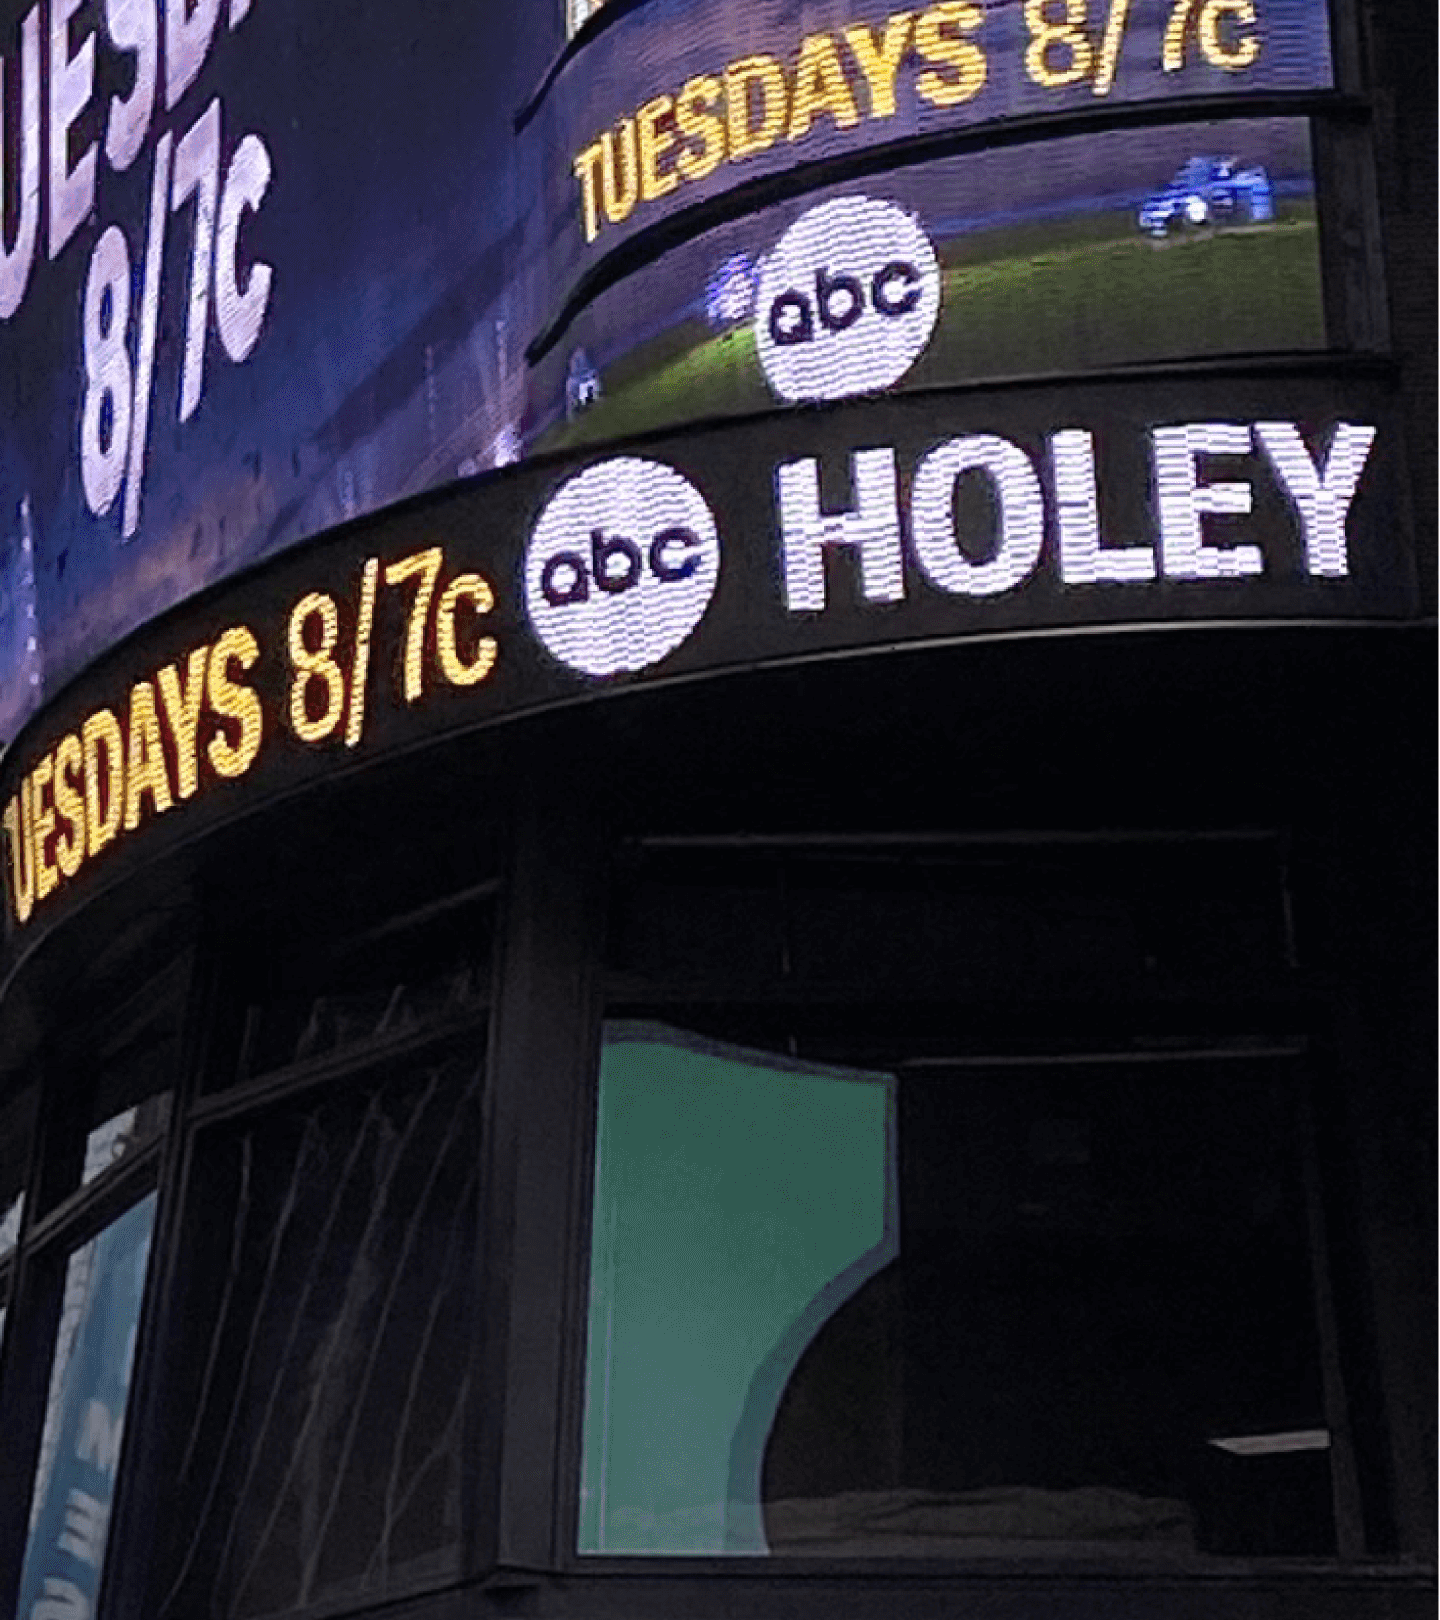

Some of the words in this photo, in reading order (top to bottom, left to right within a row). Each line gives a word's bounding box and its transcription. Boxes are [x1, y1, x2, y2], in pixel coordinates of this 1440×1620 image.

[574, 6, 989, 242] TUESDAYS
[82, 97, 273, 540] 8/7c
[769, 260, 925, 346] abc
[289, 547, 498, 748] 8/7c
[541, 526, 703, 607] abc
[777, 422, 1377, 613] HOLEY
